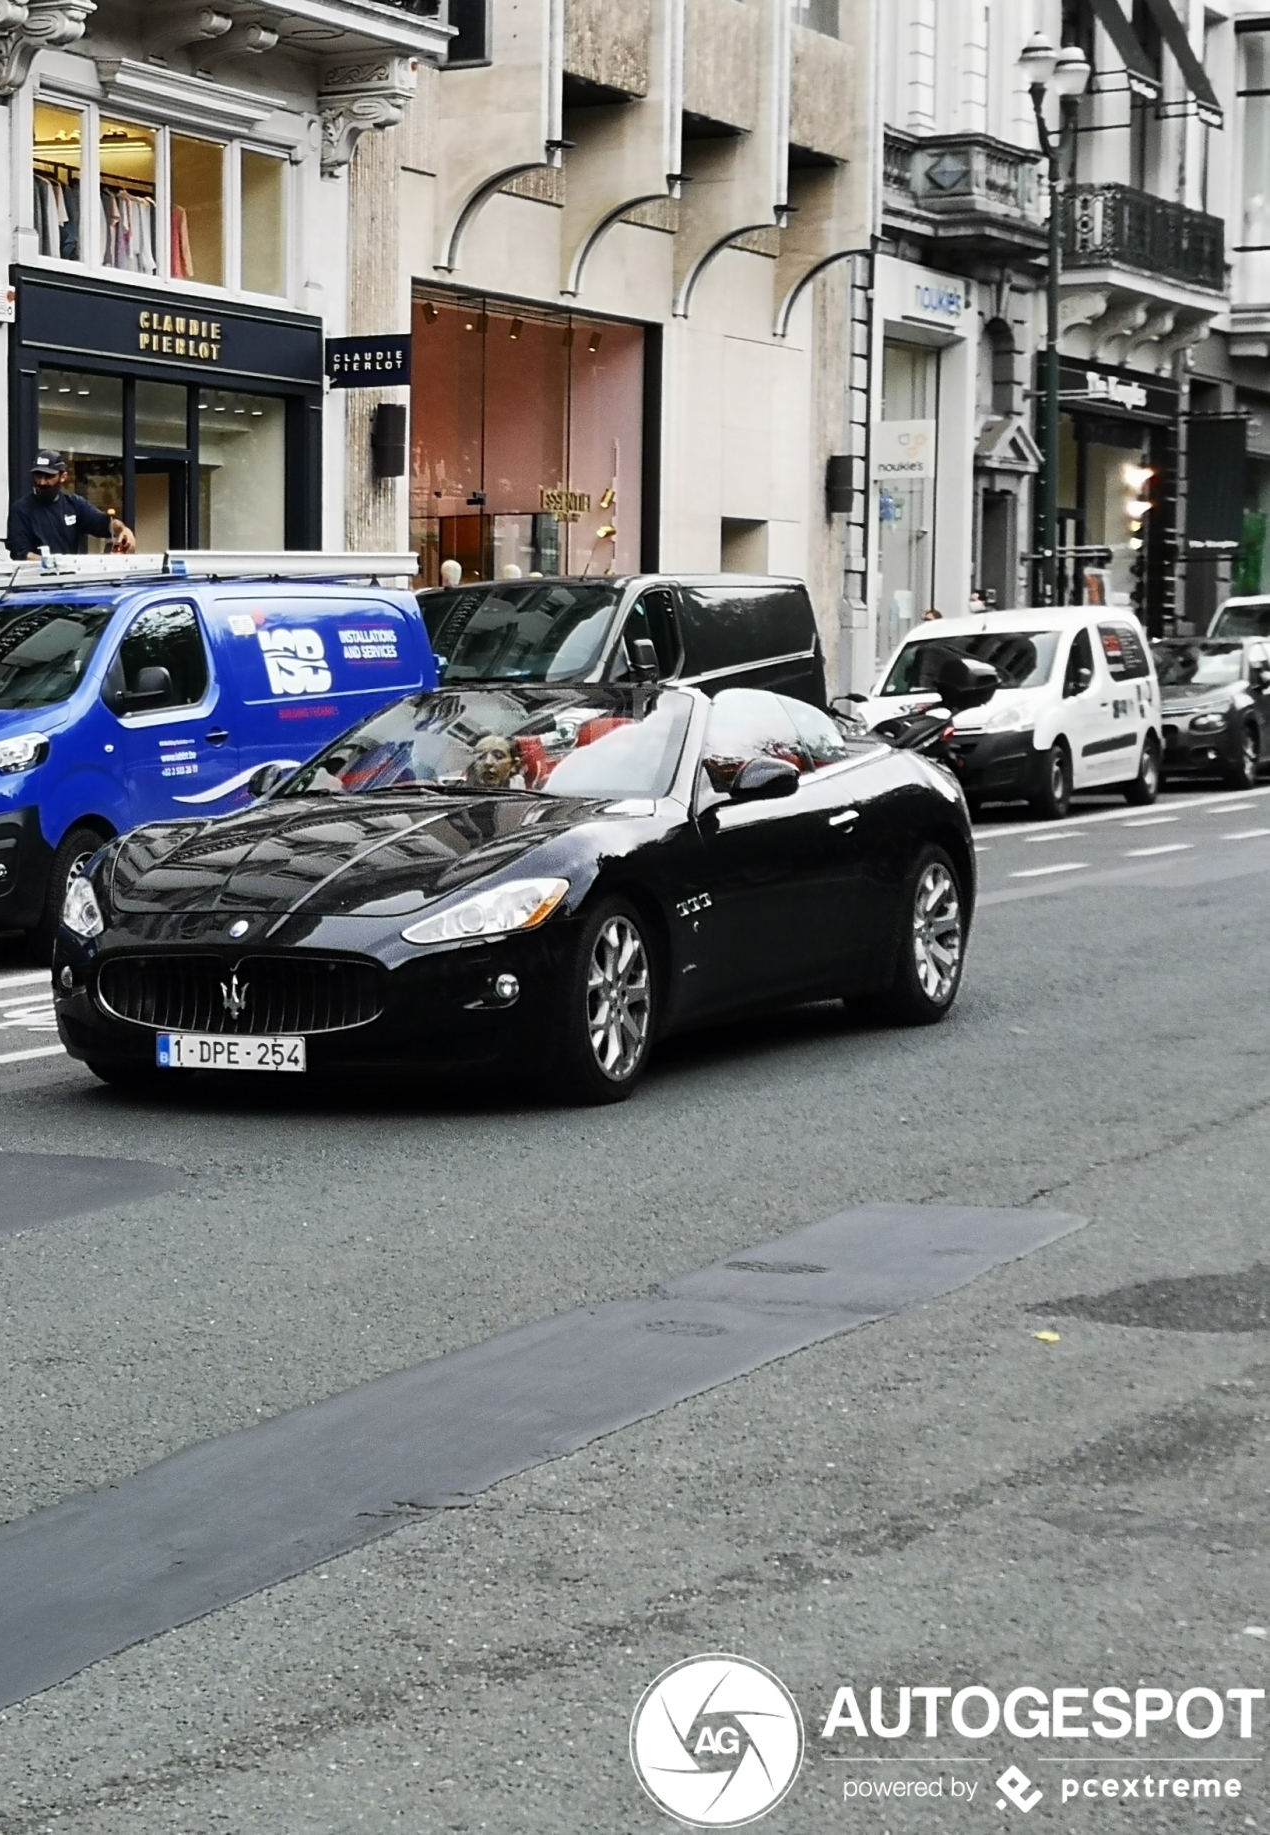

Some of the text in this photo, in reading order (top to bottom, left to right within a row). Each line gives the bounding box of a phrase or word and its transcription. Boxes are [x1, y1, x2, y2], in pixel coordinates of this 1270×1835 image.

[139, 311, 221, 340] CLAUDIE
[139, 332, 221, 361] PIERLOT
[333, 350, 403, 363] CLAUDIE
[333, 360, 403, 372] PIERLOT
[338, 629, 398, 644] INSTALLATIONS
[343, 644, 398, 659] AND SERVICES
[159, 1040, 300, 1066] B 1-DPE-254
